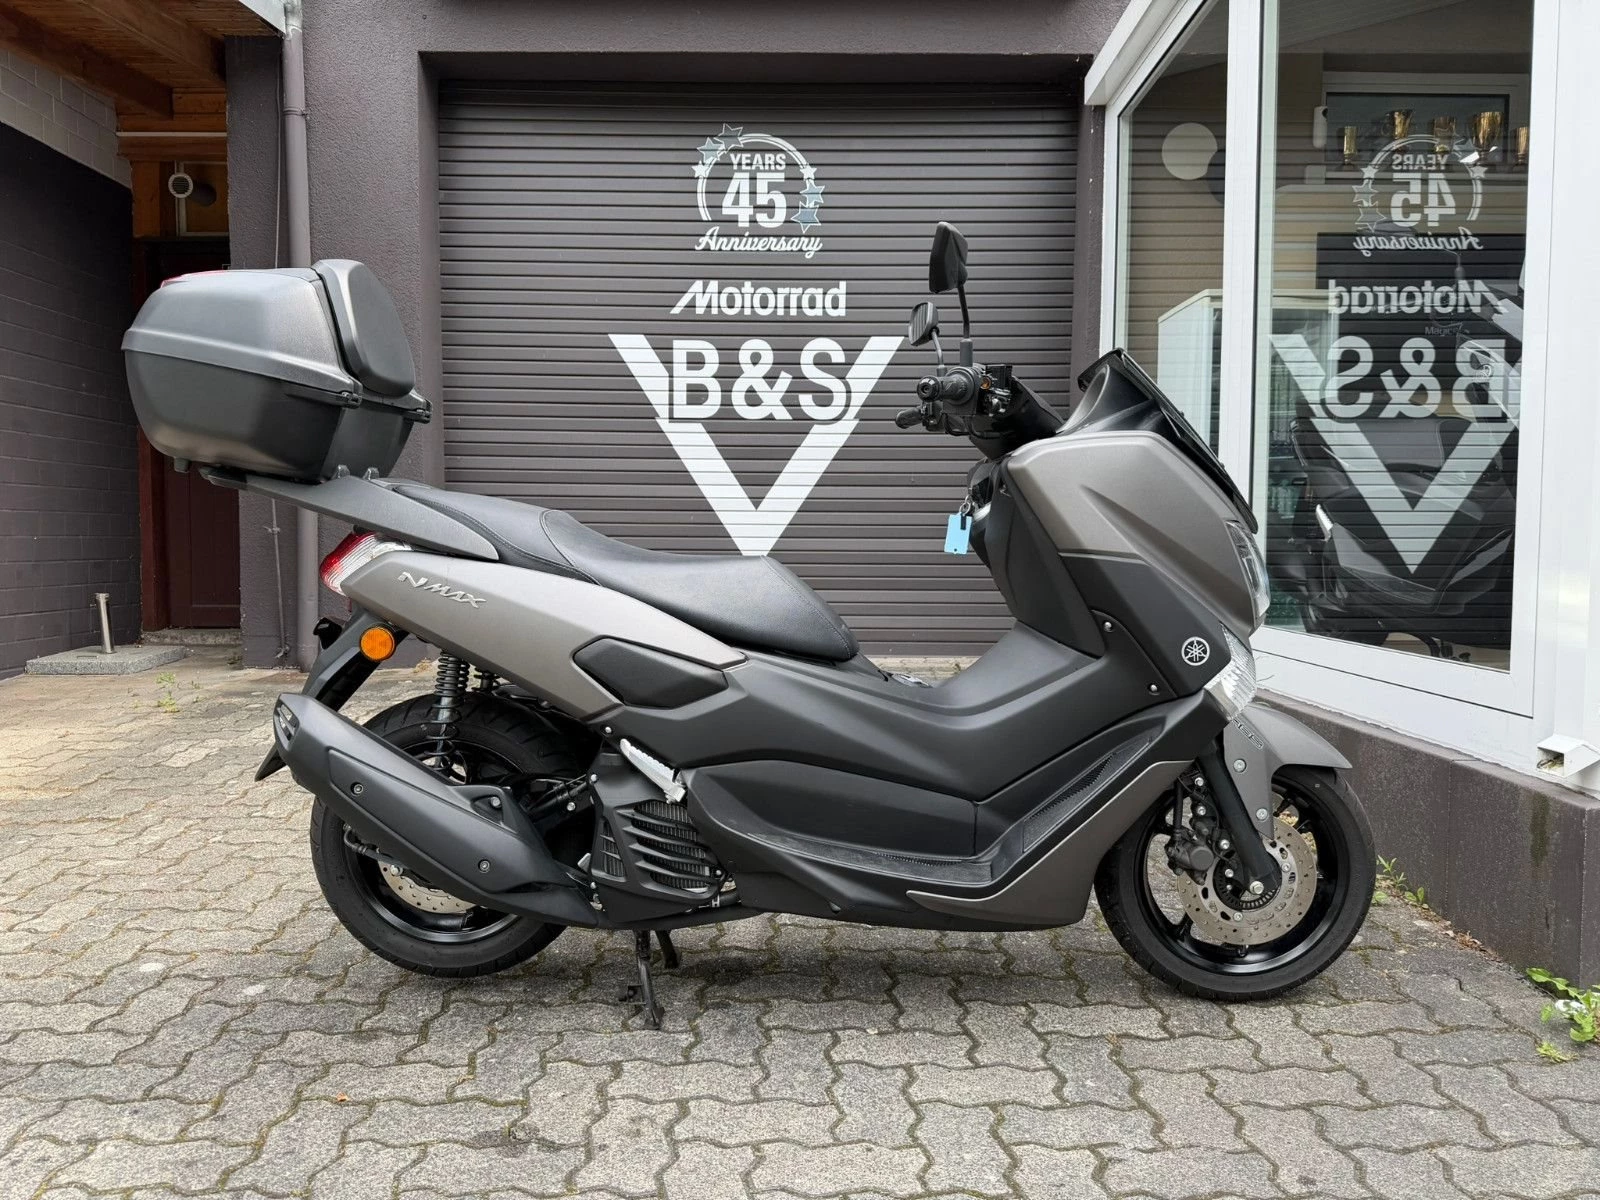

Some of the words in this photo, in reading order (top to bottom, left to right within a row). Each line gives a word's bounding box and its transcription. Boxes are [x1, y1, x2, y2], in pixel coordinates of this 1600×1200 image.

[730, 153, 786, 171] YEARS
[721, 172, 787, 228] 45
[695, 226, 823, 259] Anniversary
[669, 280, 847, 316] Motorrad
[672, 337, 847, 420] B&S
